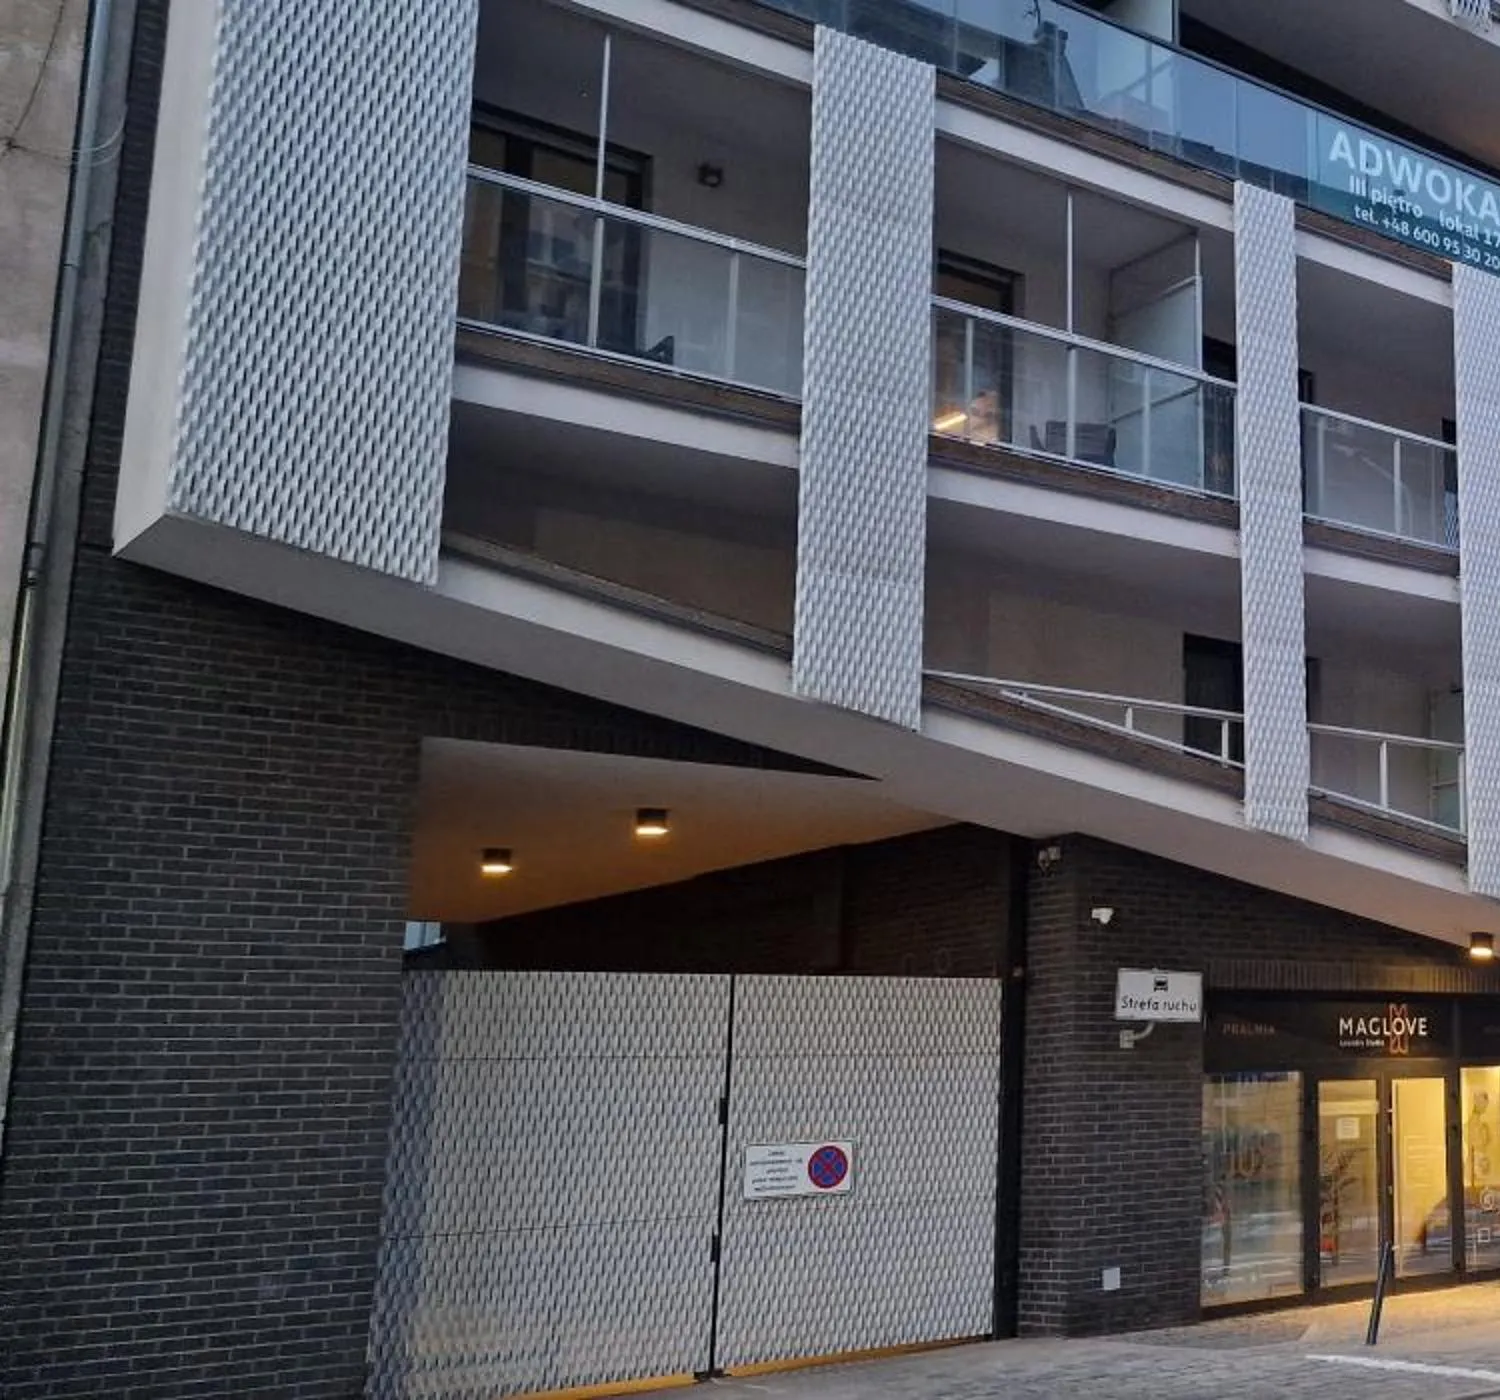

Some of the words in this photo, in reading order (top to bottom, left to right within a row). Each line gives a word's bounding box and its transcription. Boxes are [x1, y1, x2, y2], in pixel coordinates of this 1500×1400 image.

[1350, 175, 1366, 197] III
[1371, 187, 1423, 218] piętro
[1439, 210, 1479, 240] lokal
[1354, 205, 1379, 225] tel.
[1382, 217, 1409, 237] +48
[1413, 226, 1440, 247] 600
[1443, 237, 1460, 255] 95
[1463, 245, 1480, 262] 30
[1484, 252, 1500, 269] 20
[1121, 995, 1160, 1011] Strefa
[1163, 999, 1197, 1012] ruchu
[1339, 1017, 1428, 1036] MAGLOVE
